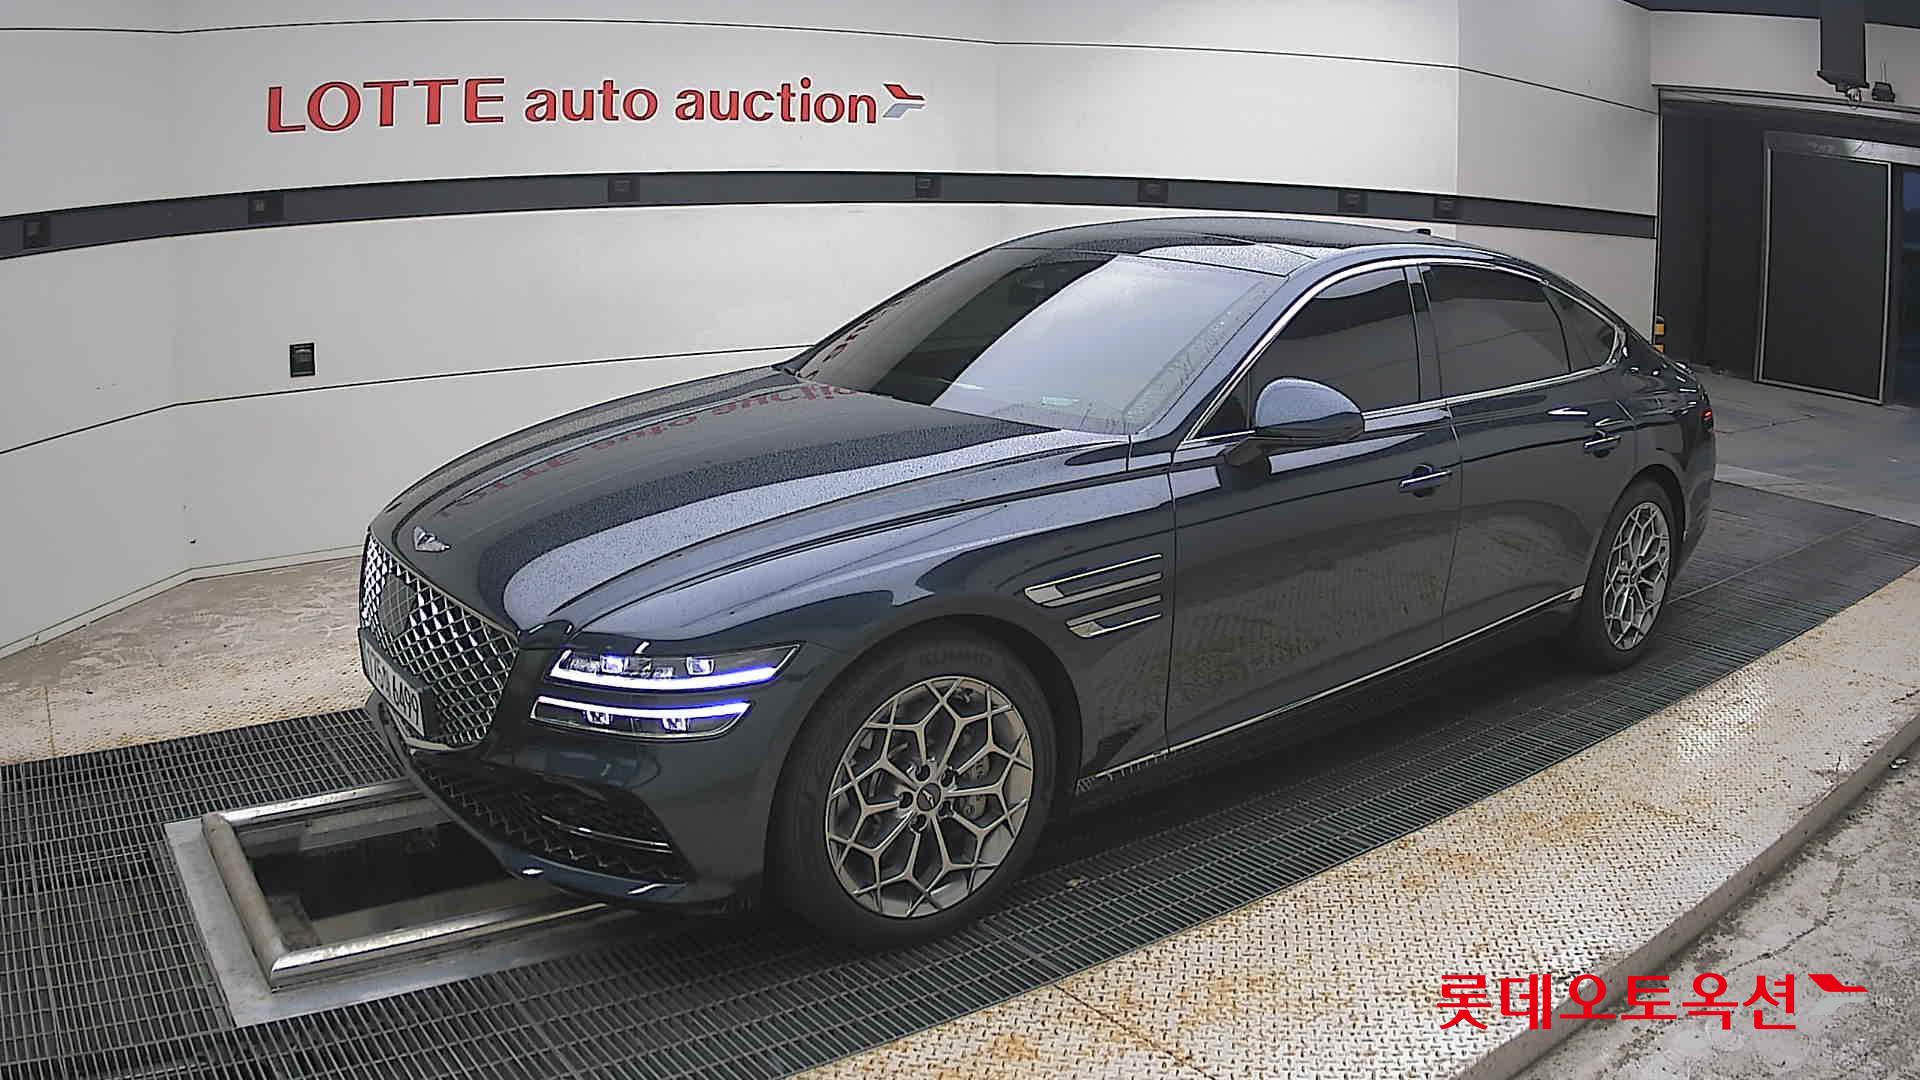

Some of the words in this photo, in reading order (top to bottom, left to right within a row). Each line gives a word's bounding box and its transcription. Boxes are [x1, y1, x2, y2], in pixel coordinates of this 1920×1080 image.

[266, 77, 503, 133] LOTTE
[525, 79, 658, 121] auto
[675, 76, 878, 124] auction
